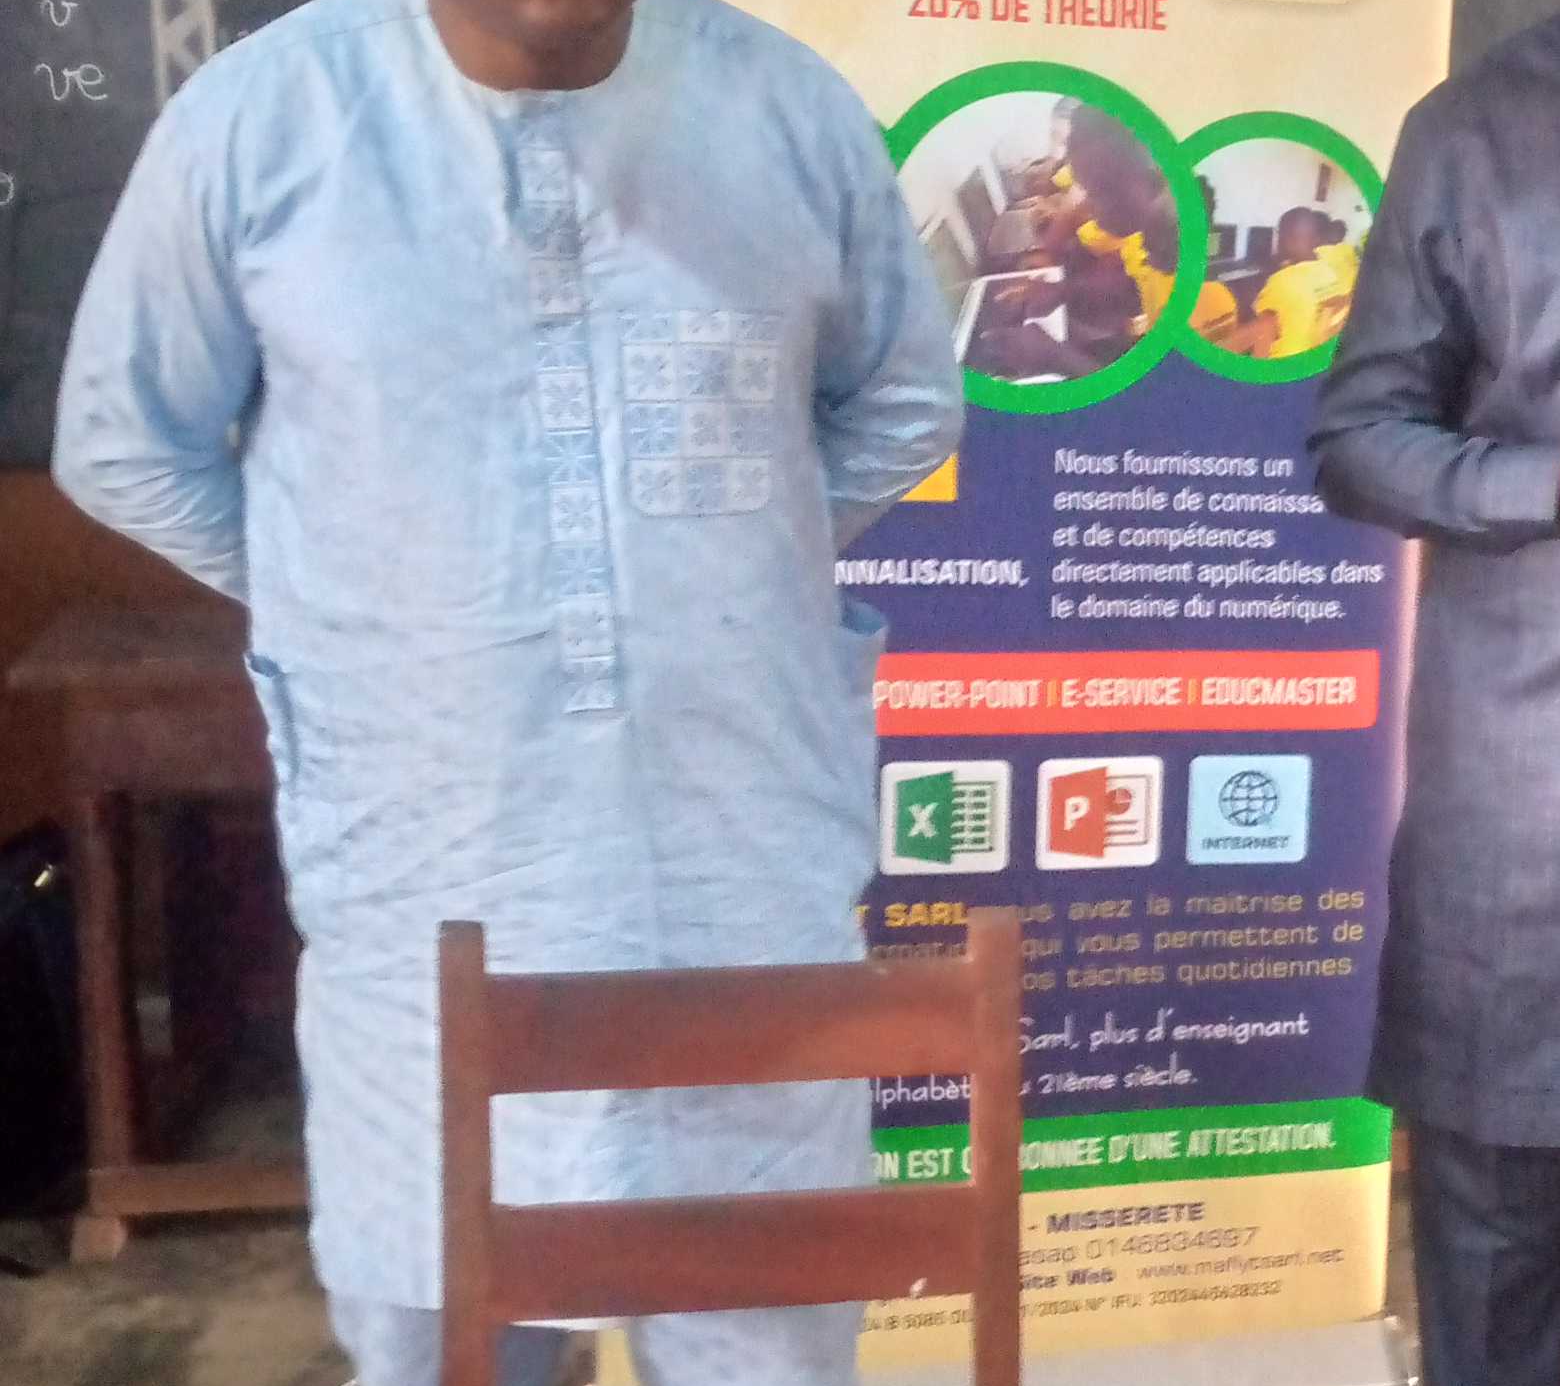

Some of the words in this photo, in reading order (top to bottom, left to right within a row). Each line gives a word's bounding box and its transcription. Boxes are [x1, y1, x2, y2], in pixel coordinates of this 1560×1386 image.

[1054, 448, 1117, 475] Nous
[1122, 448, 1256, 478] fournissons
[1263, 457, 1294, 477] un
[1054, 487, 1168, 512] ensemble
[1174, 489, 1202, 512] de
[1209, 490, 1324, 513] connaissa
[1052, 525, 1078, 548] et
[1084, 524, 1113, 549] de
[1118, 524, 1276, 553] compétences
[834, 559, 1030, 587] NNALISATION,
[1052, 558, 1192, 584] directement
[1198, 558, 1324, 589] applicables
[1330, 558, 1384, 583] dans
[1050, 593, 1072, 619] le
[1078, 593, 1179, 619] domaine
[1184, 593, 1215, 619] du
[1220, 593, 1346, 623] numérique.
[872, 679, 1038, 711] POWER-POINT
[1062, 677, 1182, 709] E-SERVICE
[1202, 676, 1356, 706] EDUCMASTER
[1202, 835, 1292, 852] INTERNET
[885, 902, 968, 928] SARL
[1069, 899, 1133, 921] avez
[1146, 894, 1171, 915] la
[1318, 888, 1365, 911] des
[1077, 932, 1141, 954] vous
[1153, 924, 1319, 952] permettent
[1332, 920, 1365, 943] de
[1023, 970, 1056, 991] os
[1177, 956, 1353, 985] quotidiennes
[1089, 1011, 1140, 1052] plus
[1145, 1007, 1311, 1044] d'enseignant
[873, 1073, 971, 1110] lphabèt
[907, 1147, 954, 1179] EST
[1046, 1201, 1206, 1235] MISSERETE
